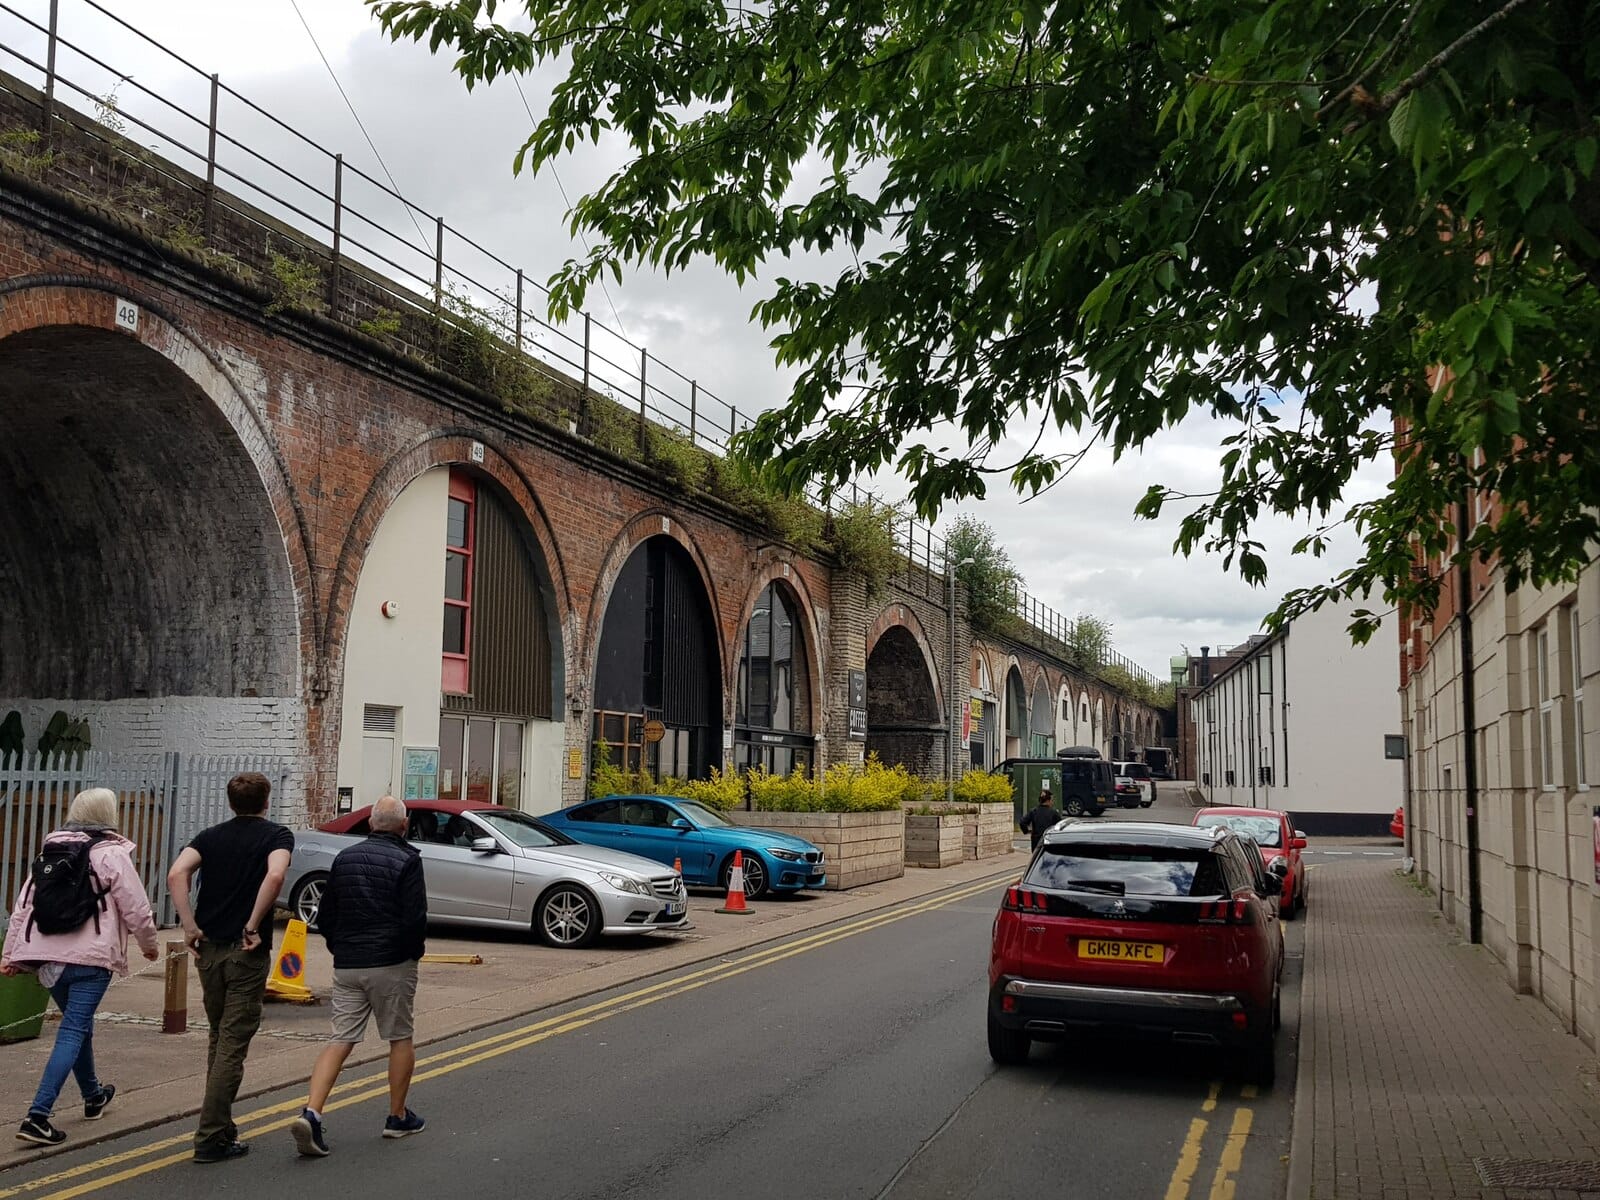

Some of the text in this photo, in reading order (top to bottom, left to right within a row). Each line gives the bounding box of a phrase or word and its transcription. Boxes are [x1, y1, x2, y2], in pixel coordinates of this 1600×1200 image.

[119, 306, 135, 325] 48
[474, 446, 483, 459] 49
[850, 709, 866, 729] COFFEE
[1087, 941, 1155, 959] GK19 XFC
